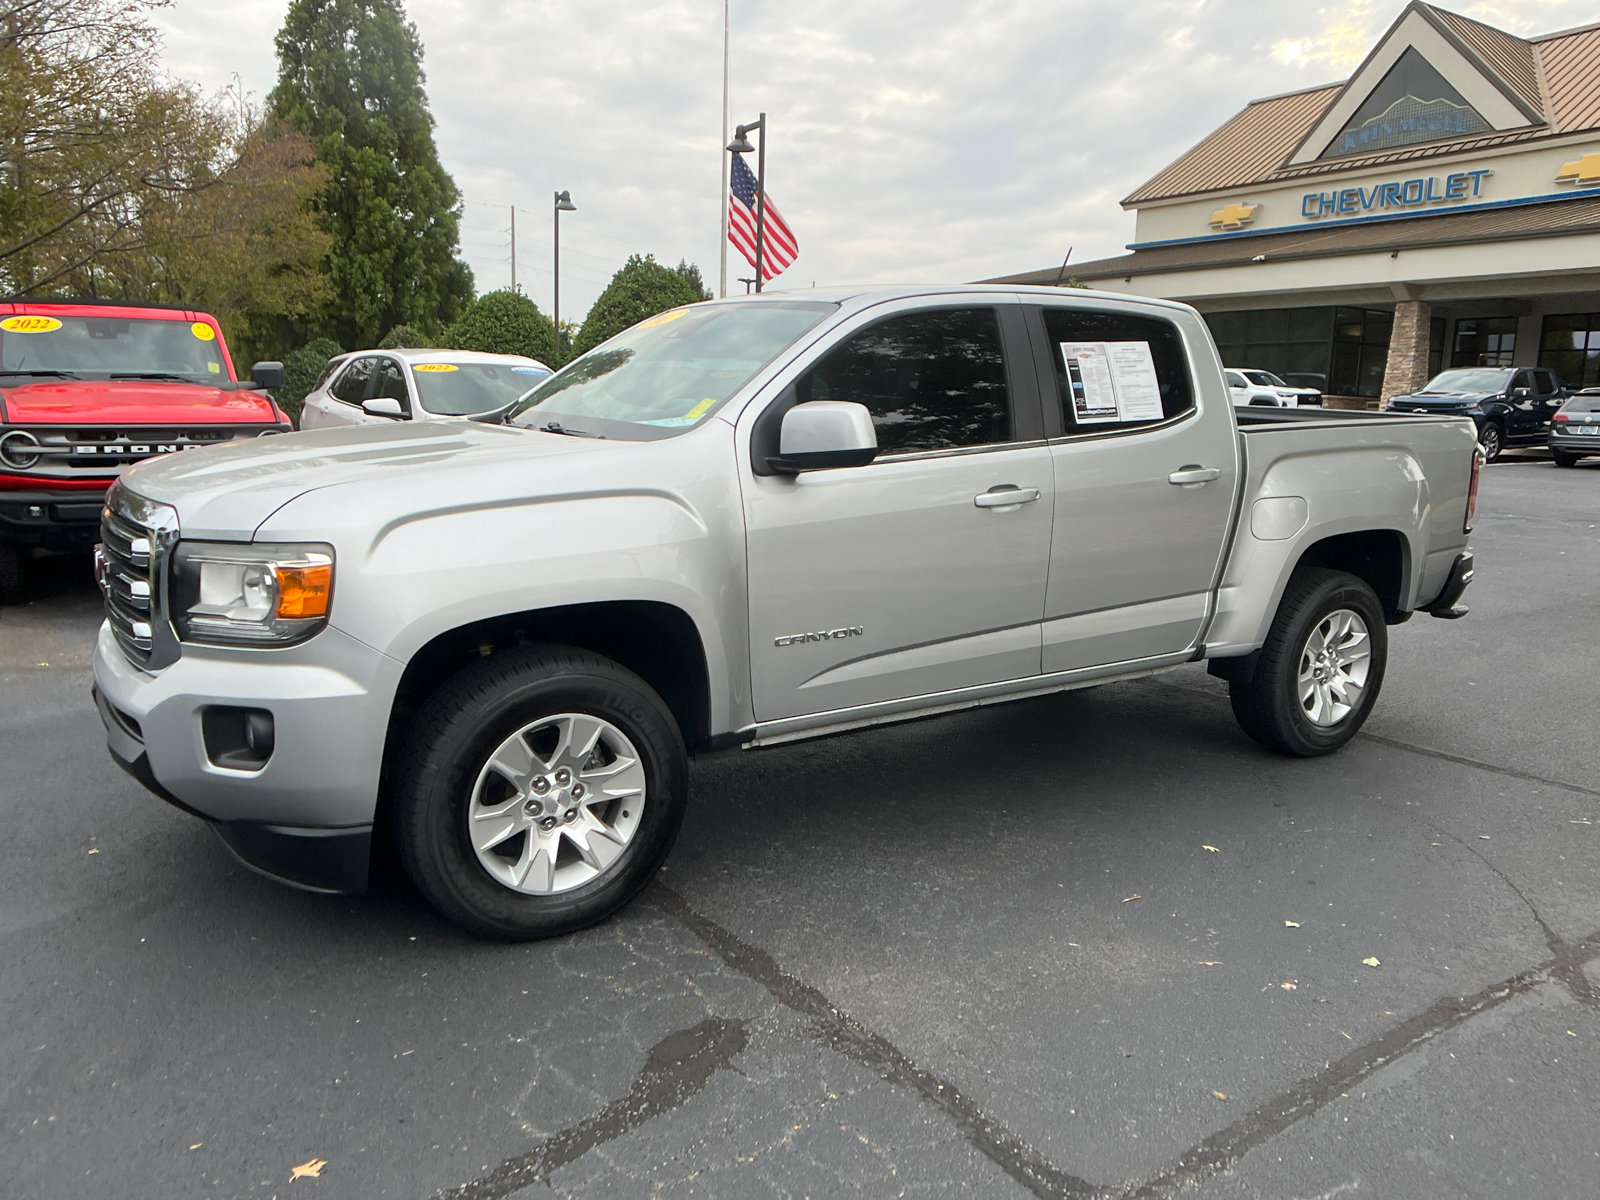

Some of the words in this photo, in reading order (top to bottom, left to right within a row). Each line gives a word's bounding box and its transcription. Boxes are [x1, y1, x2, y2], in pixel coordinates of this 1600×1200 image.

[1339, 119, 1393, 153] JOHN
[1399, 111, 1470, 133] MEGEL
[1301, 169, 1491, 217] CHEVROLET
[10, 318, 51, 330] 2022
[774, 625, 864, 648] CANYON
